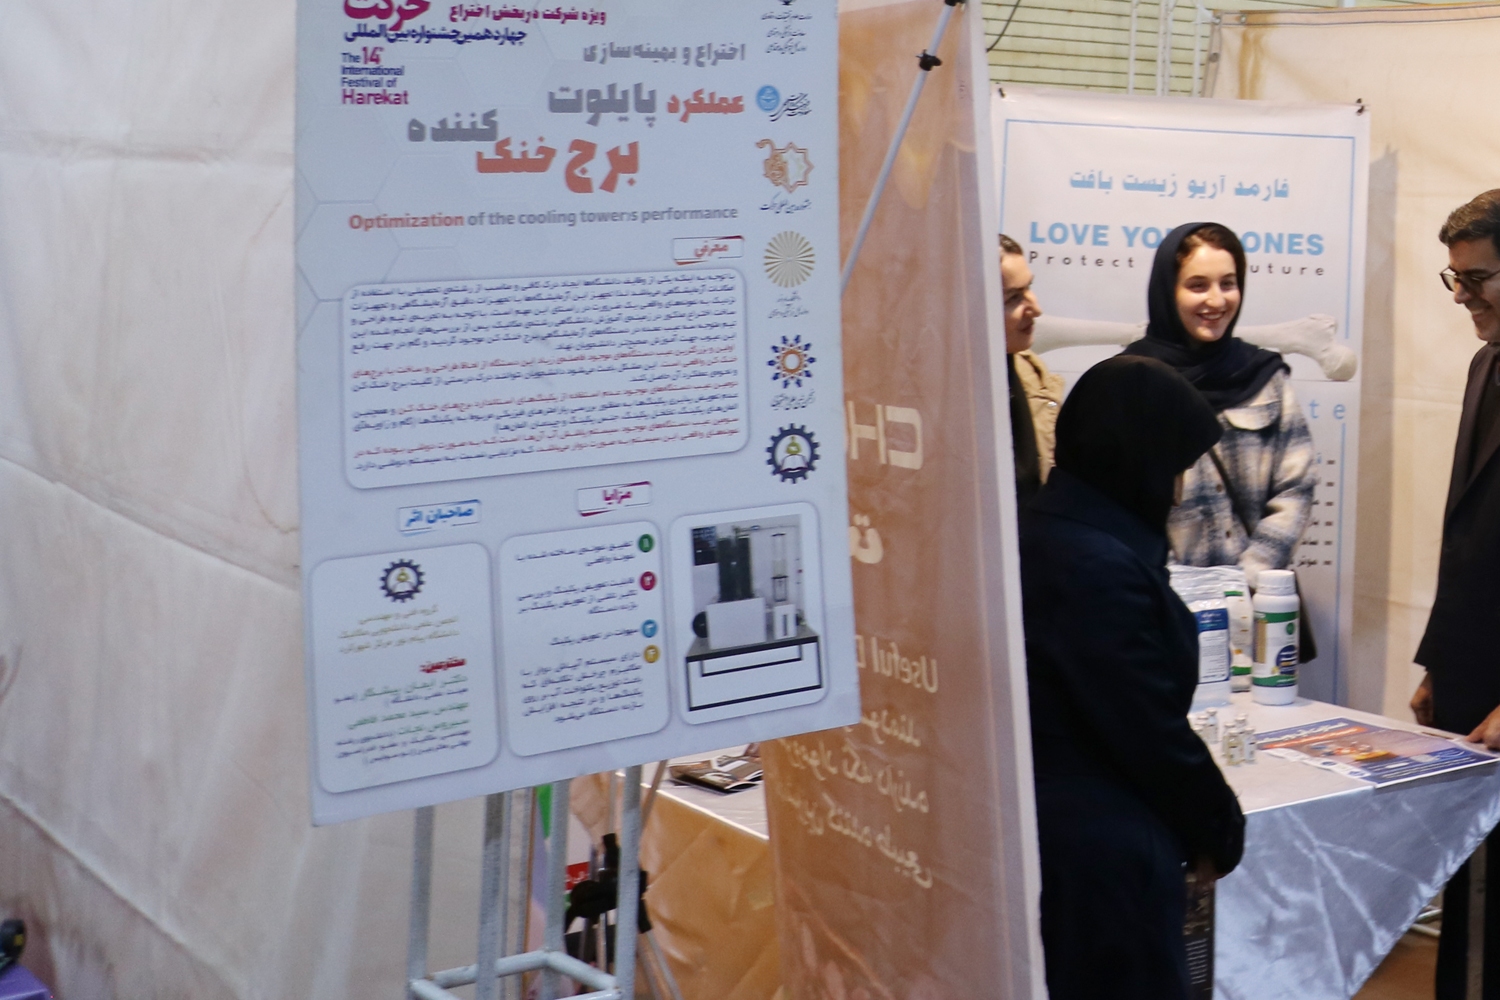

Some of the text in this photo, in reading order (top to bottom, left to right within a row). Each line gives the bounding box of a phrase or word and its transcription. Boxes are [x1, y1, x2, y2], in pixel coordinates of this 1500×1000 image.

[449, 4, 490, 23] اختراع
[542, 6, 580, 25] شرکت
[581, 9, 607, 26] ویژه
[341, 52, 361, 64] The
[682, 46, 693, 65] و
[694, 41, 746, 64] اختراع
[341, 65, 405, 76] International
[341, 77, 397, 88] Festival of
[341, 88, 409, 105] Harekat
[547, 82, 658, 127] پایلوت
[667, 91, 745, 124] عملکرد
[408, 109, 640, 194] برج خنک کننده
[1069, 169, 1290, 200] فارمد آریو زیست بافت
[349, 213, 464, 232] Optimization
[467, 211, 485, 227] of
[488, 211, 515, 227] the
[518, 208, 577, 227] cooling
[641, 206, 739, 224] performance
[1030, 221, 1110, 247] LOVE
[1240, 231, 1325, 256] ONES
[694, 240, 729, 258] معرفی
[1028, 251, 1326, 277] Protect uture
[602, 489, 632, 505] مزایا
[405, 506, 474, 528] صاحبان اثر
